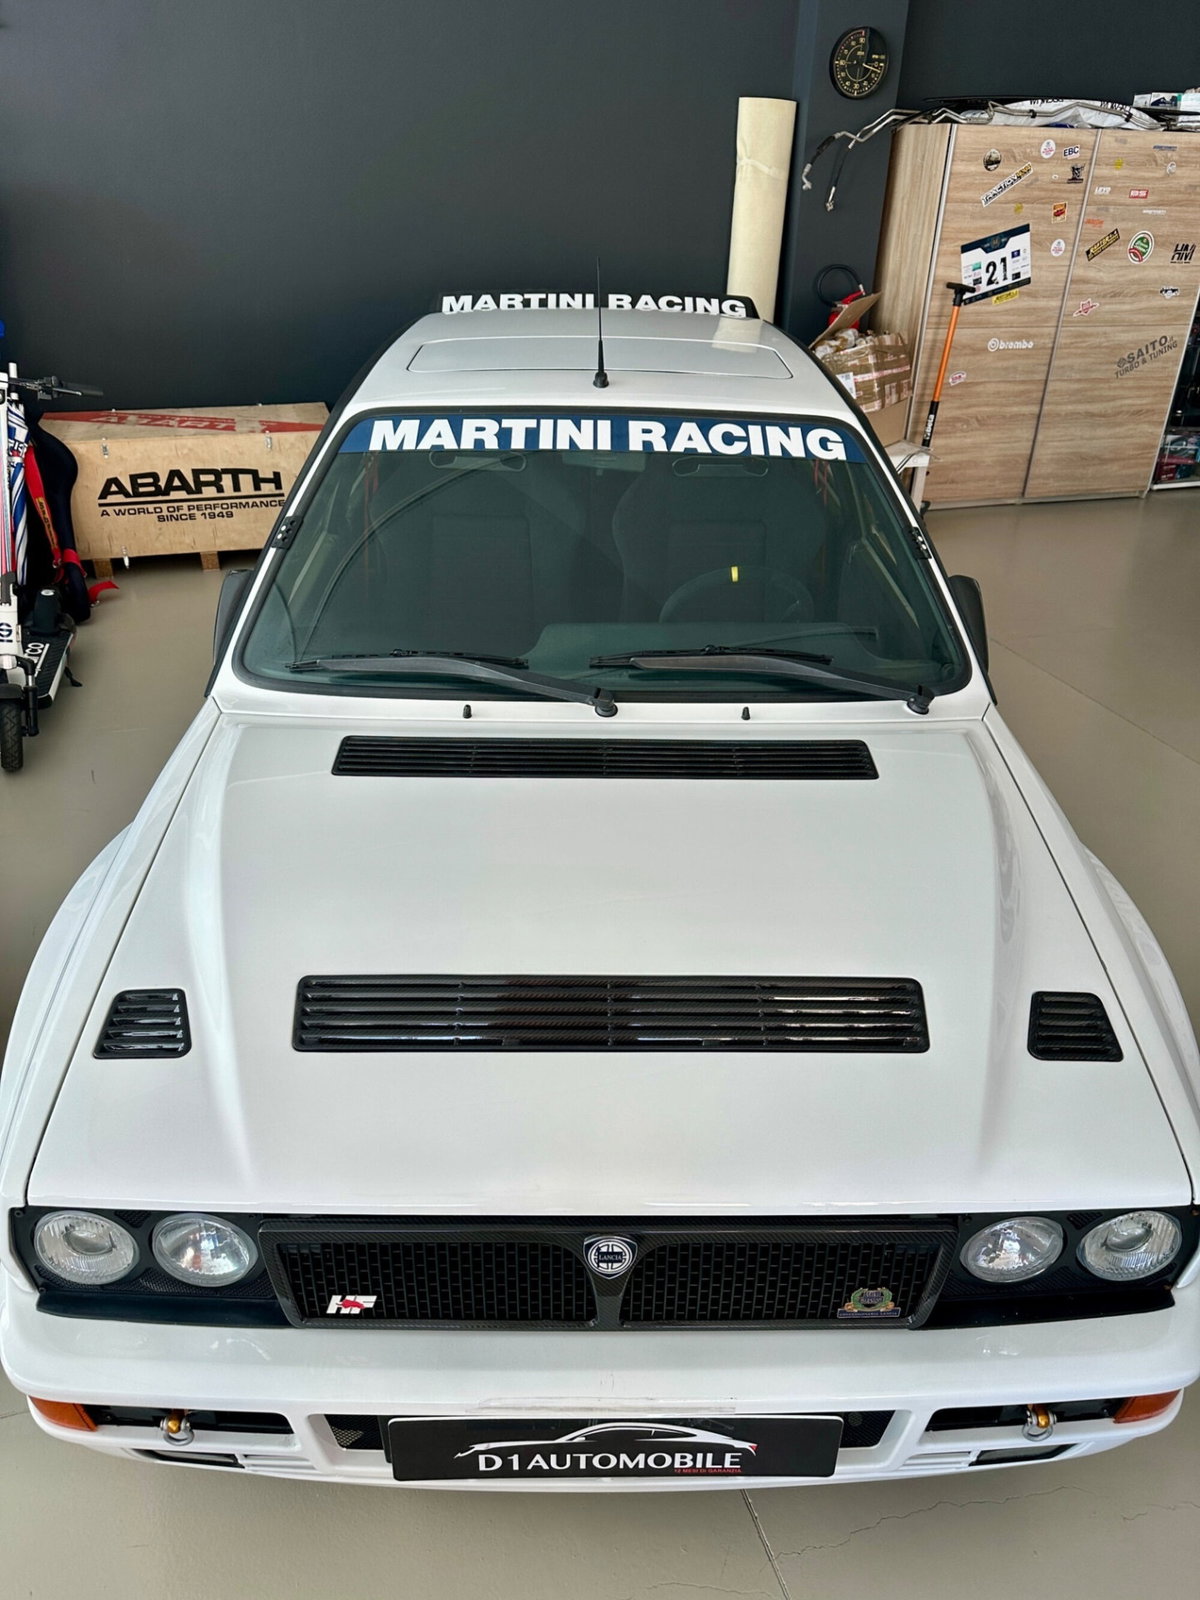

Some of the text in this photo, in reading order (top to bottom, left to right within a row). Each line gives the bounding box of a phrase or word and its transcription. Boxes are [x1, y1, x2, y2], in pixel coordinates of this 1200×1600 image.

[1063, 146, 1079, 157] EBC
[985, 256, 1008, 286] 21
[442, 293, 747, 318] MARTINI RACING
[999, 339, 1034, 349] brembo
[1114, 361, 1140, 379] TURBO
[1149, 340, 1178, 361] TUNING
[368, 418, 847, 461] MARTINI RACING
[98, 468, 283, 500] ABARTH
[101, 500, 285, 517] A WORLD OF PERFORMANCE
[157, 511, 234, 523] SINCE 1949
[326, 1295, 377, 1314] HF
